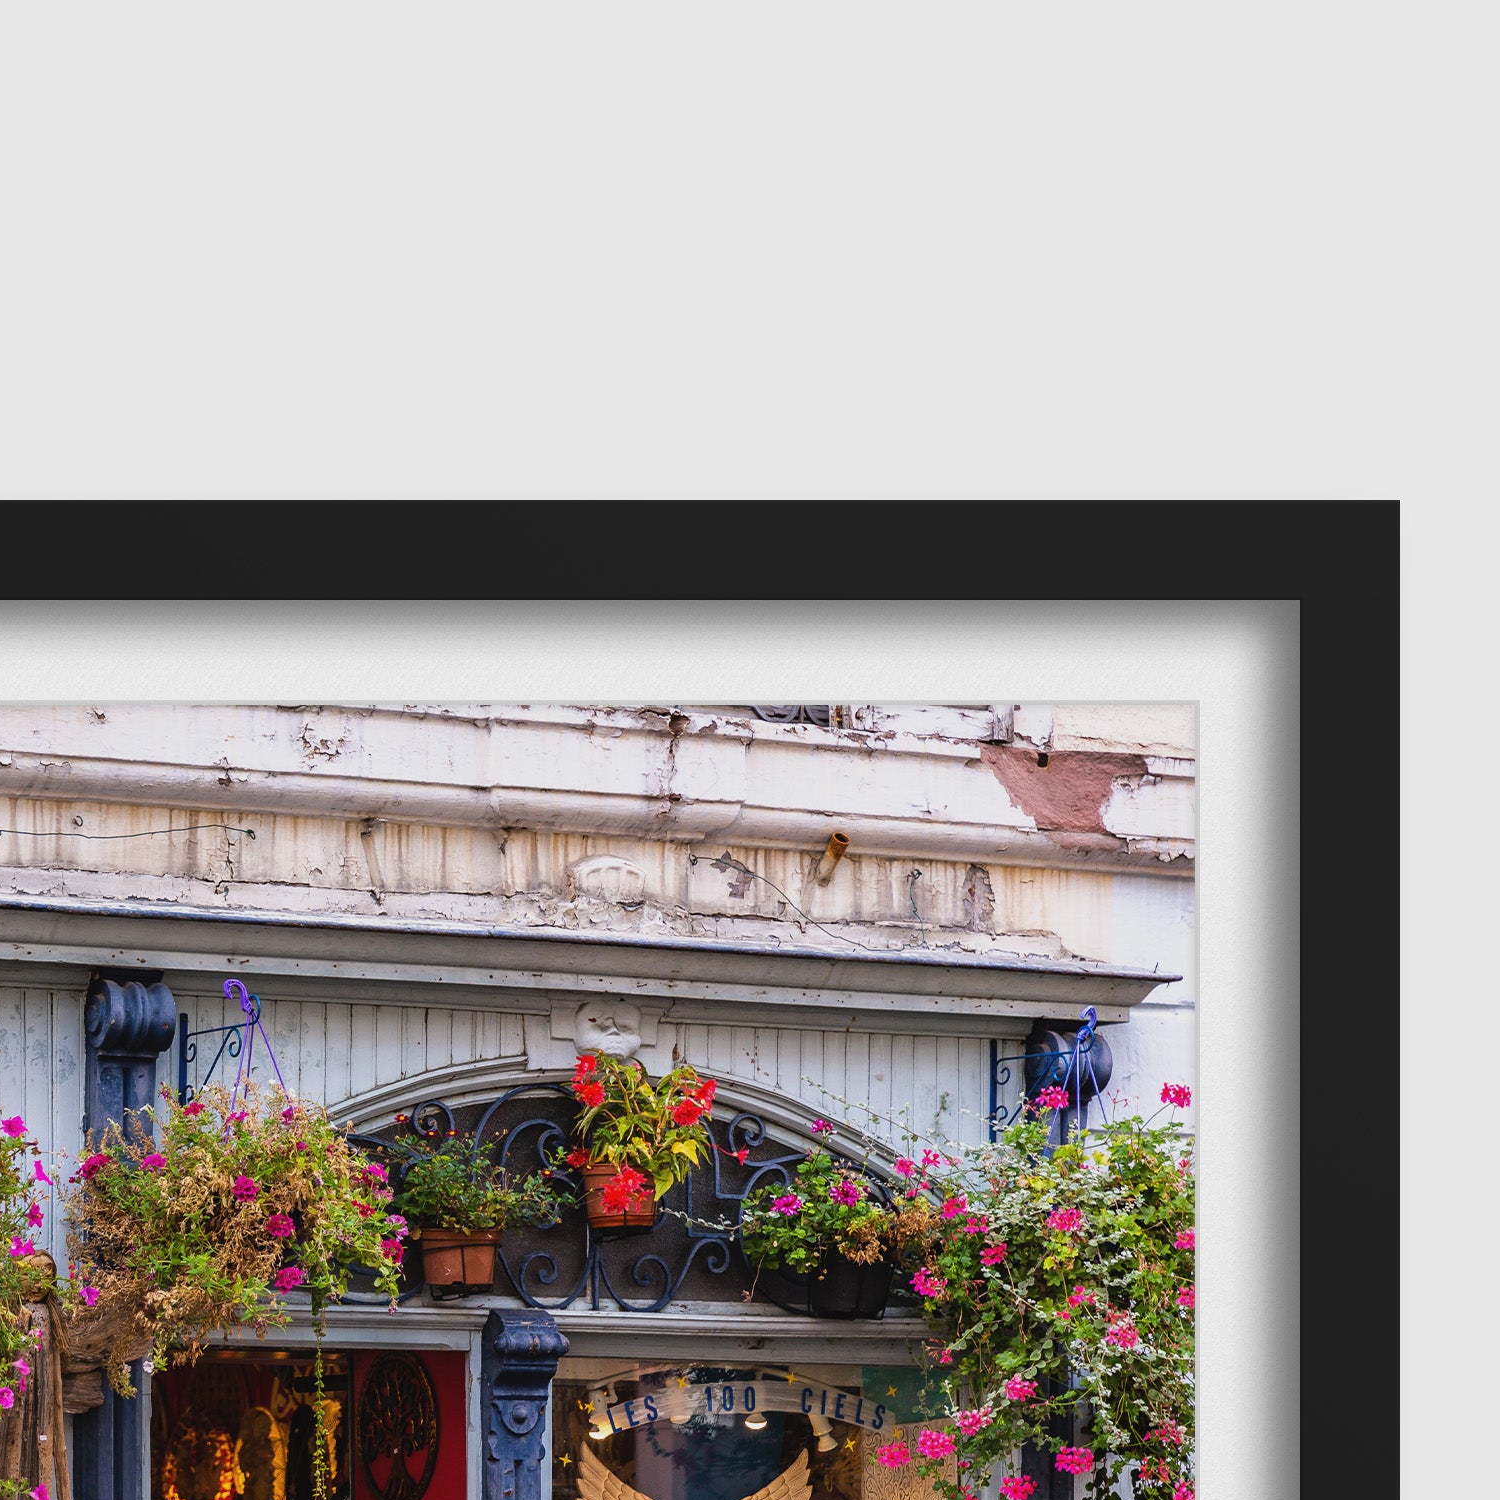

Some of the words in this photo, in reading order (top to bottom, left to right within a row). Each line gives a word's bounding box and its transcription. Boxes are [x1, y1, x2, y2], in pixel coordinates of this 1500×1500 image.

[606, 1395, 658, 1434] LES
[704, 1385, 756, 1412] 100
[801, 1387, 886, 1430] CIELS
